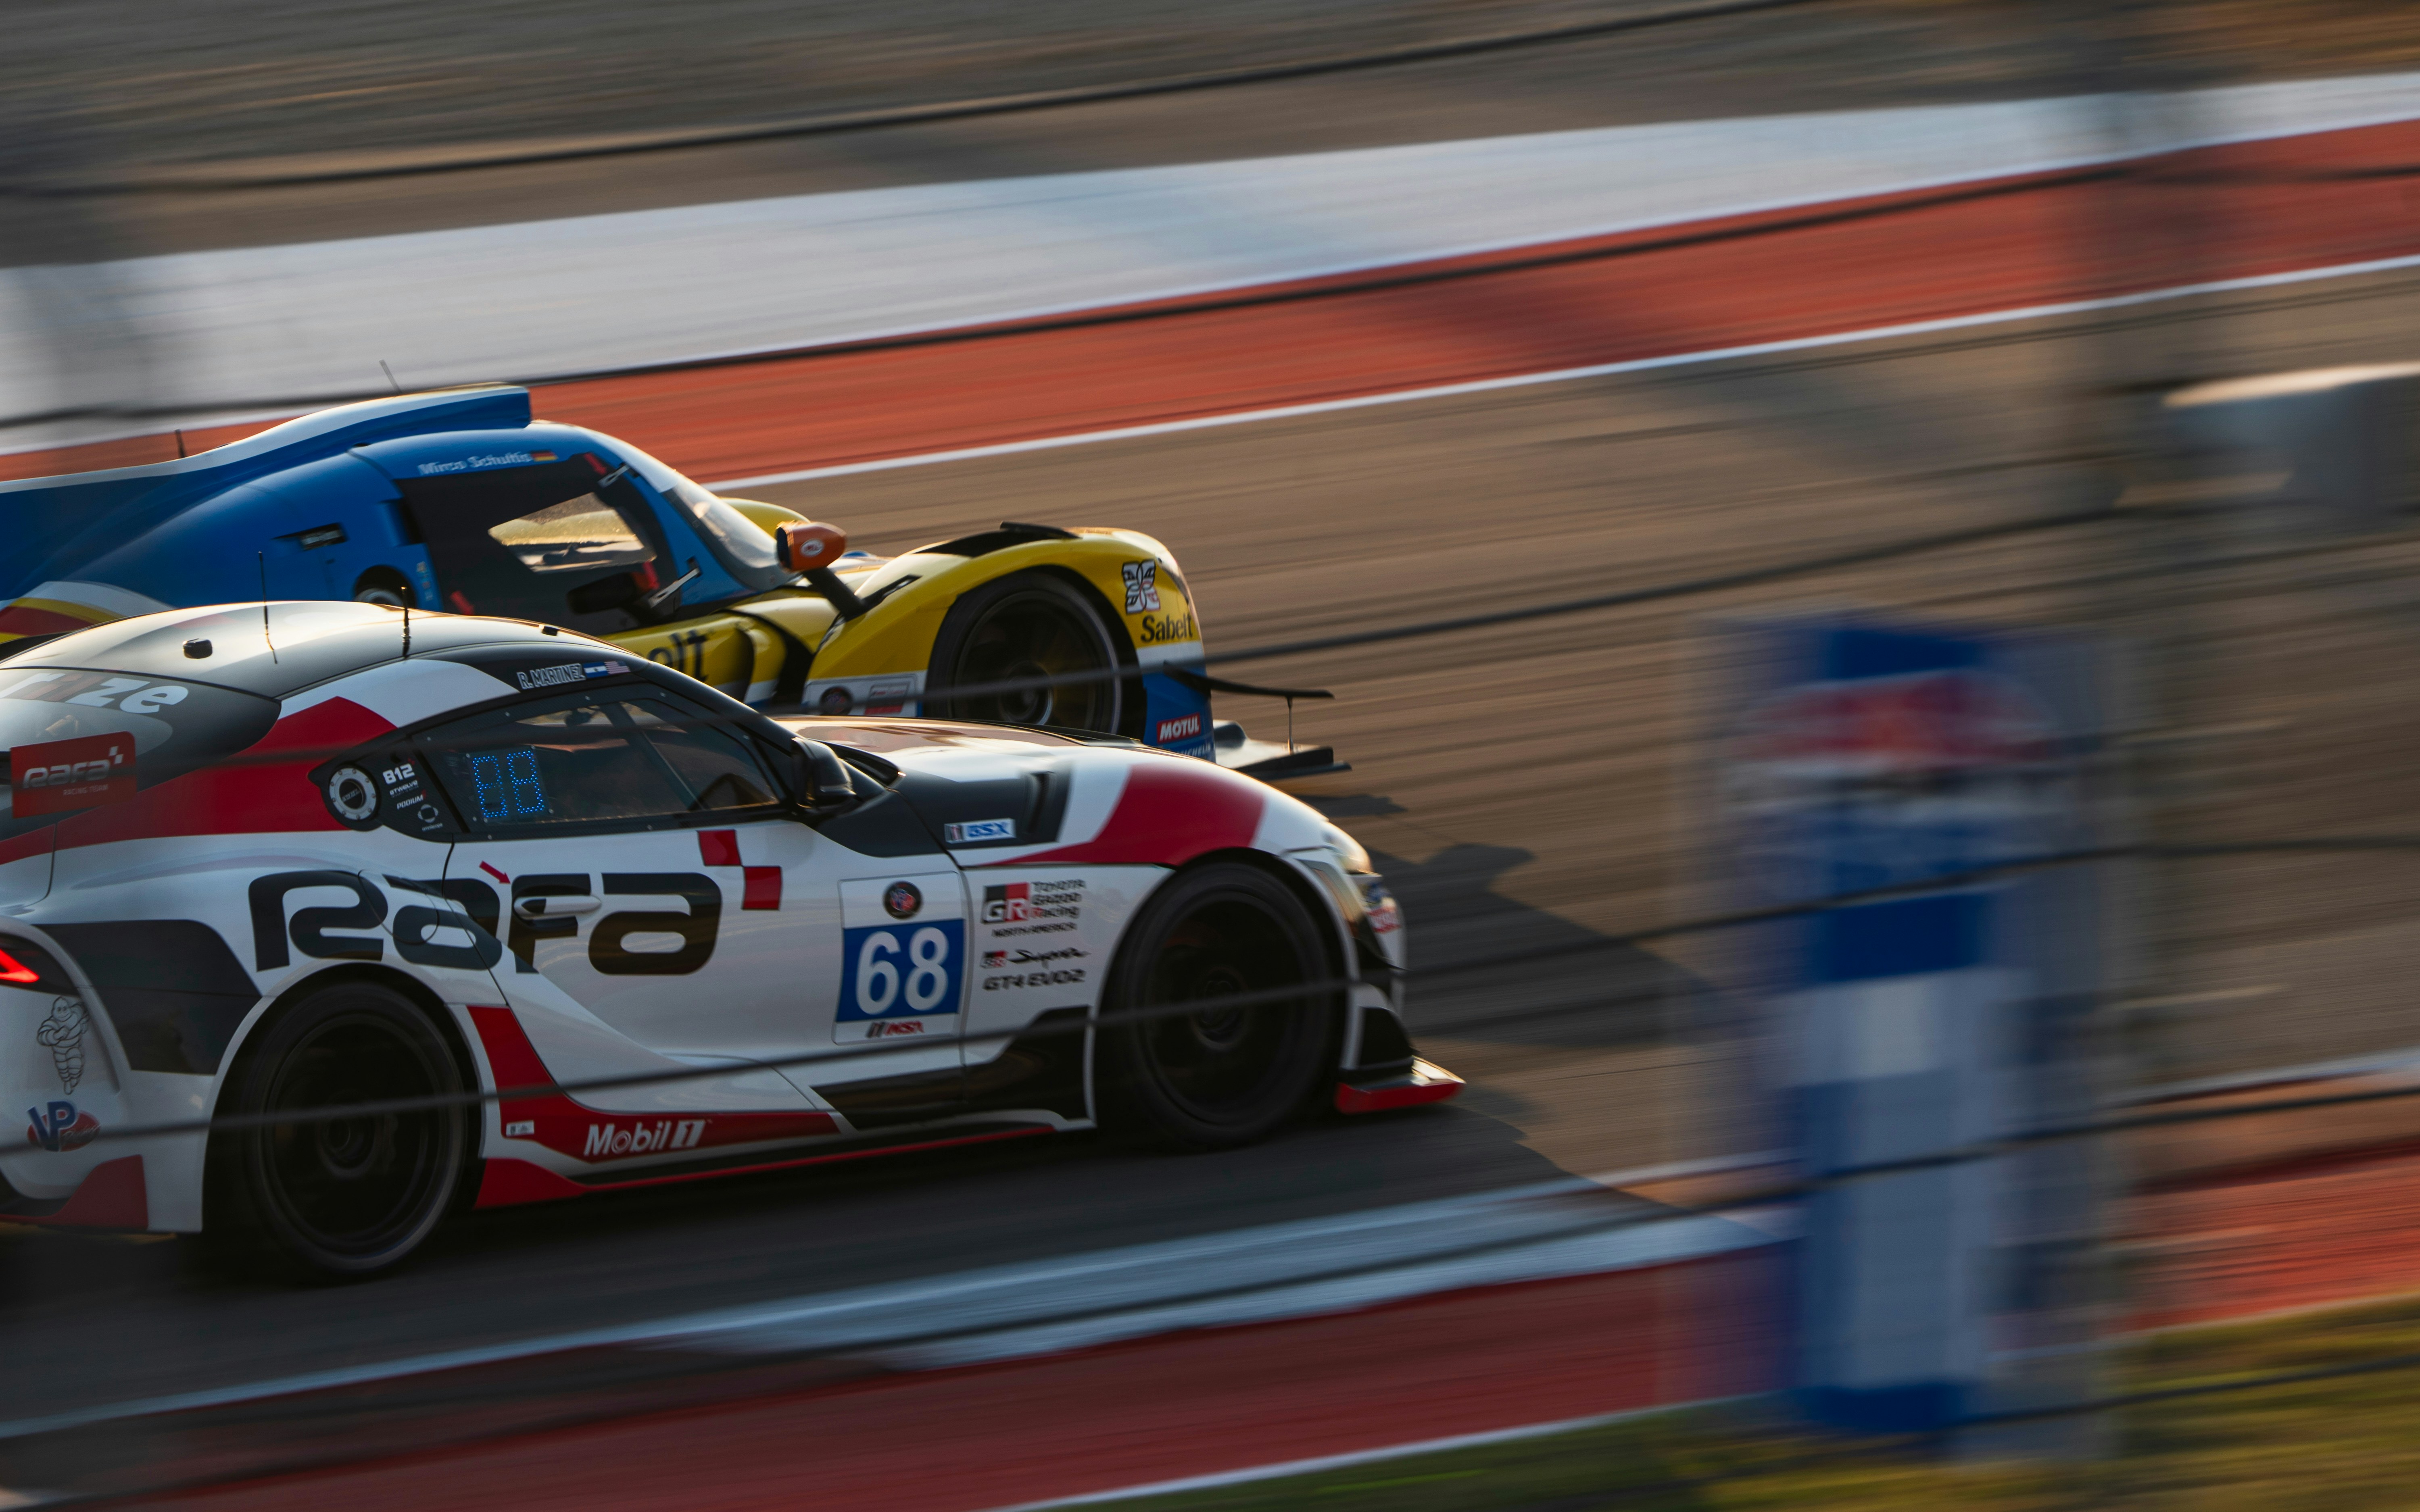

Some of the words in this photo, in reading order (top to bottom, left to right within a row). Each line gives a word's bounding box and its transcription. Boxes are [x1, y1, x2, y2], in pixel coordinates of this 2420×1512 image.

[1140, 612, 1193, 643] Sabelt
[647, 629, 708, 682] elt
[517, 672, 535, 689] R.
[530, 663, 586, 687] MARTINEZ
[1159, 715, 1200, 741] MOTUL
[383, 763, 415, 785] 812
[63, 787, 88, 796] RACING
[397, 794, 424, 810] PODIUM
[981, 898, 1029, 925] GR
[855, 927, 949, 1015] 68
[27, 1101, 75, 1152] VP
[583, 1120, 672, 1156] Mobil
